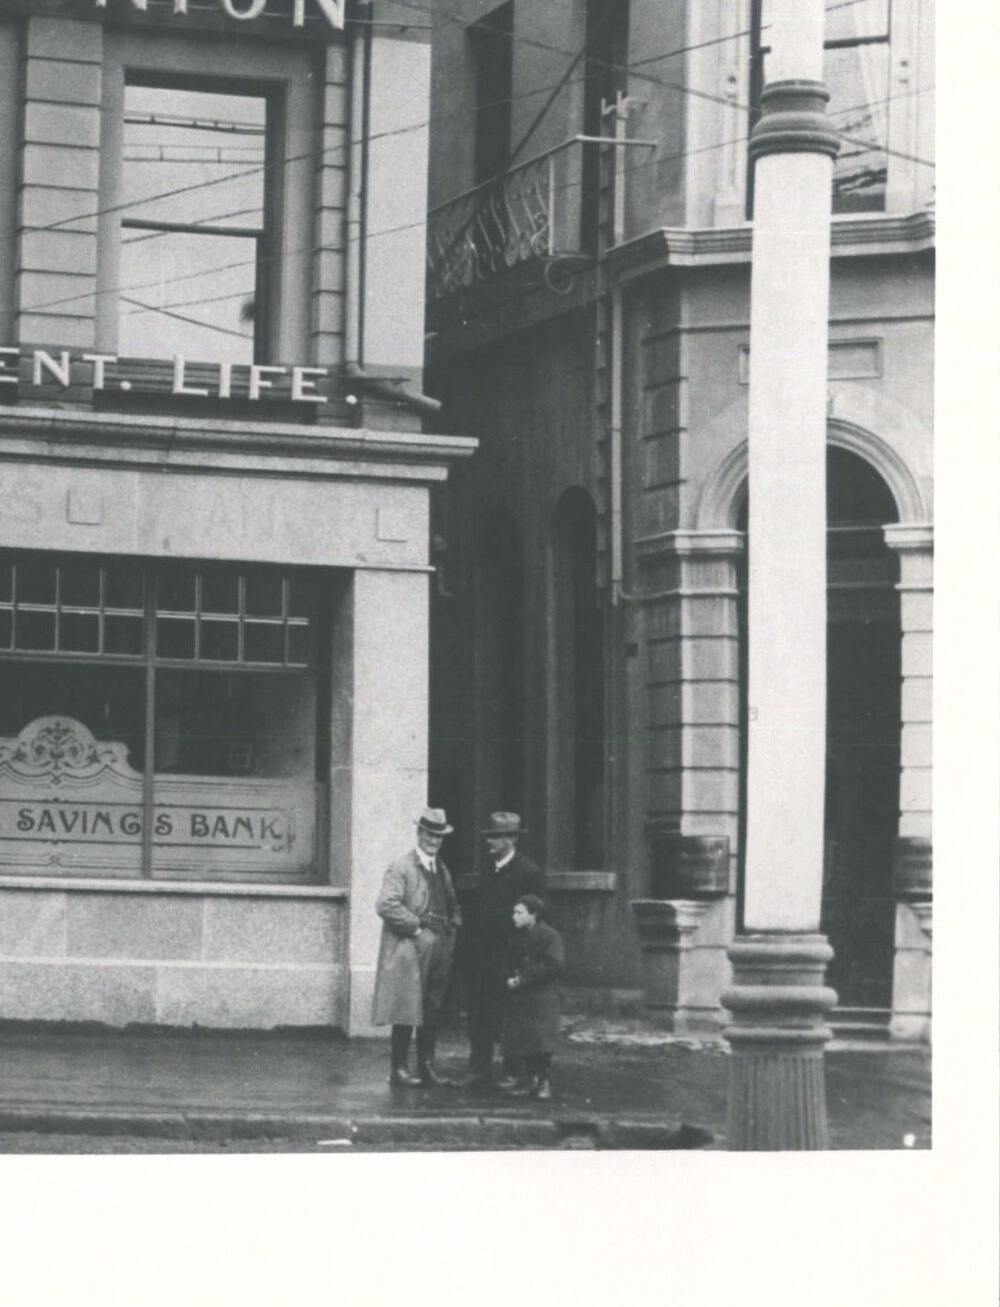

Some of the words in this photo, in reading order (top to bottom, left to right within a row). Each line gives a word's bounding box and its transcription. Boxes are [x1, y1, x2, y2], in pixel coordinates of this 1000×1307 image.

[172, 354, 358, 405] LIFE.
[17, 807, 173, 838] SAVINGS
[190, 813, 284, 841] BANK
